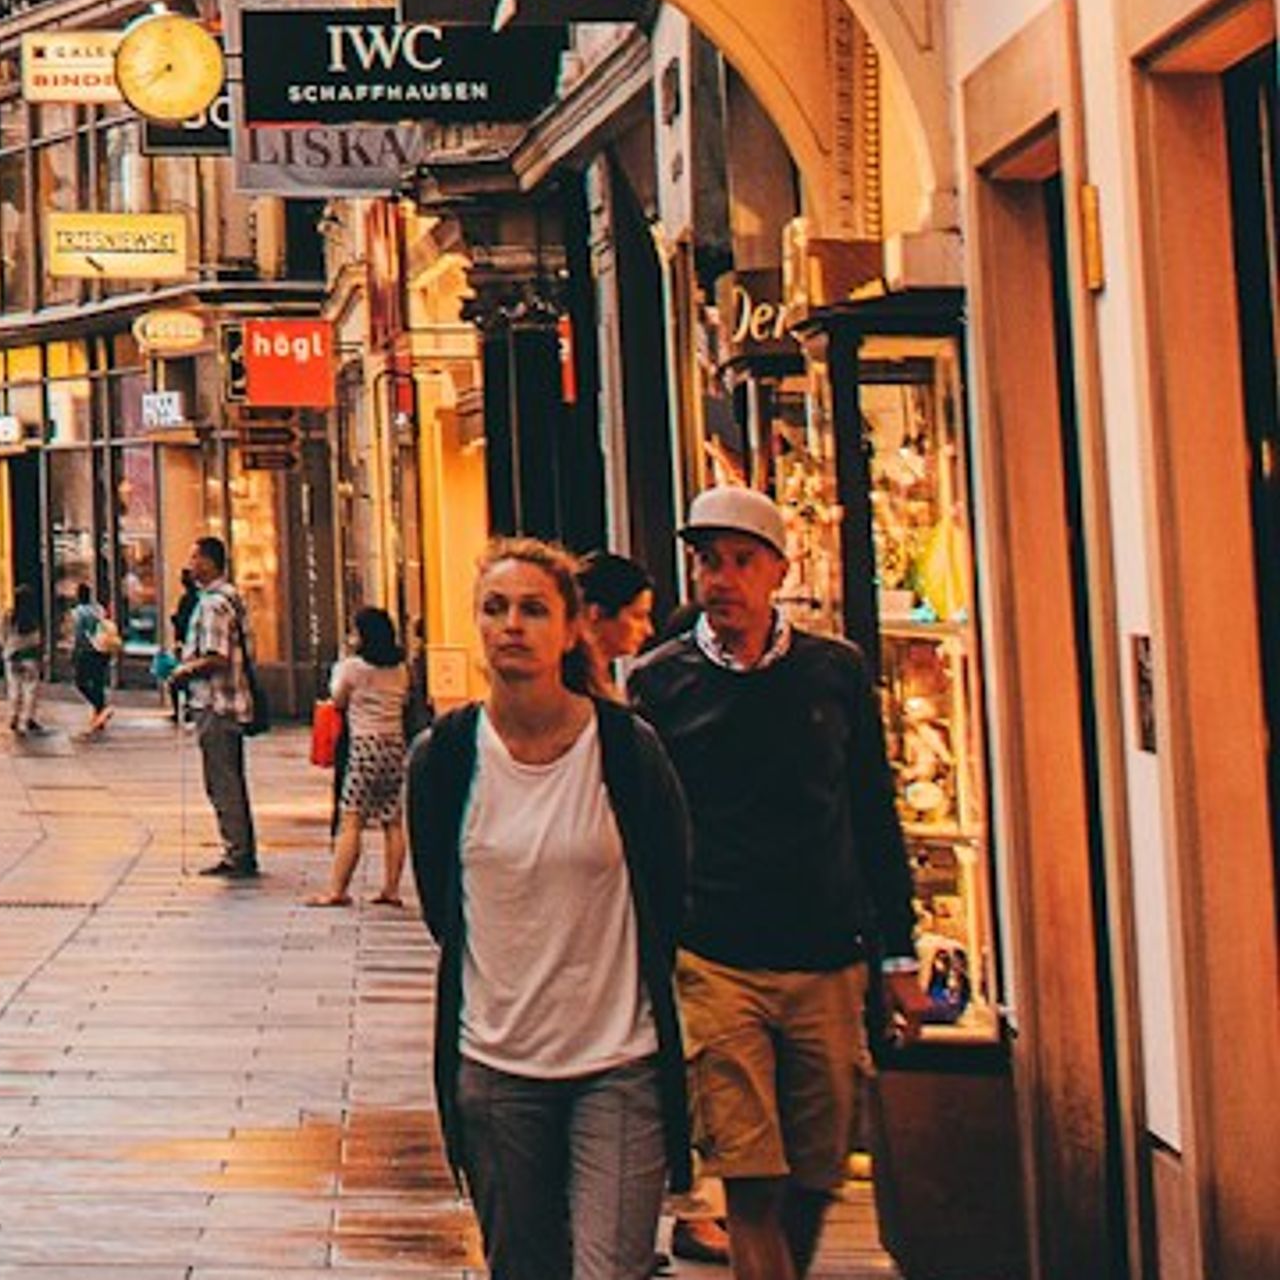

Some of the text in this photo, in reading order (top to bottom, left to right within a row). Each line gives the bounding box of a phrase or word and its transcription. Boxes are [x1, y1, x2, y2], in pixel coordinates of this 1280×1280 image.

[326, 24, 444, 73] IWC
[288, 81, 489, 102] SCHAFFHAUSEN
[248, 126, 416, 167] LISKA
[252, 331, 324, 364] högl
